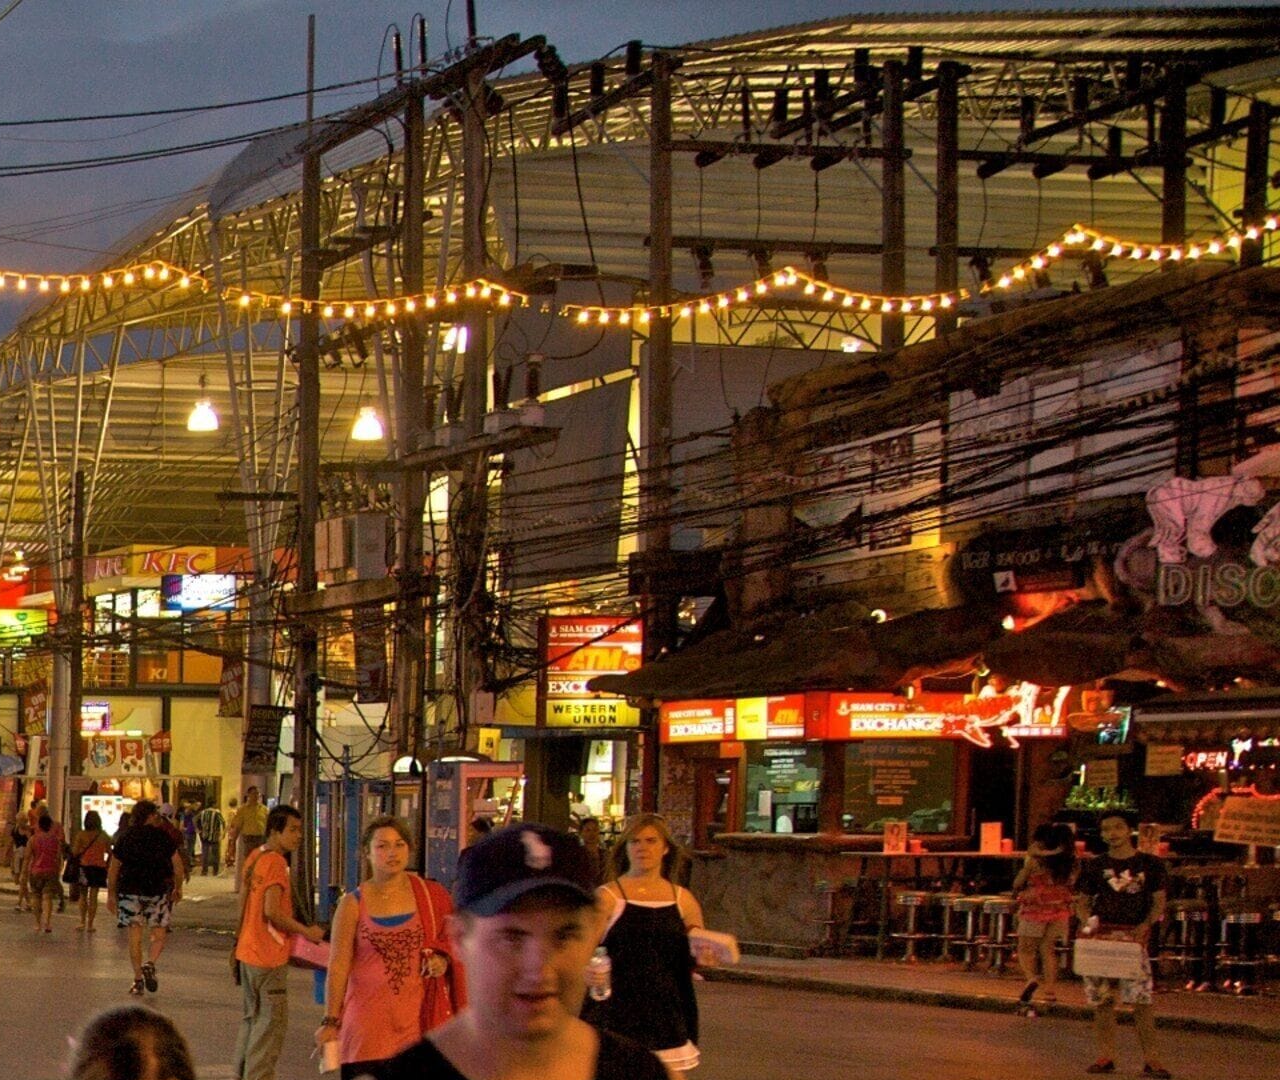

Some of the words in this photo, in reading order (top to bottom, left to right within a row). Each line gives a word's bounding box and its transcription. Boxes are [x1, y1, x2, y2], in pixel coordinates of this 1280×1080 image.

[143, 551, 210, 574] KFC
[566, 648, 624, 671] ATM
[553, 704, 617, 714] WESTERN
[572, 715, 617, 724] UNION
[1185, 751, 1228, 770] OPEN
